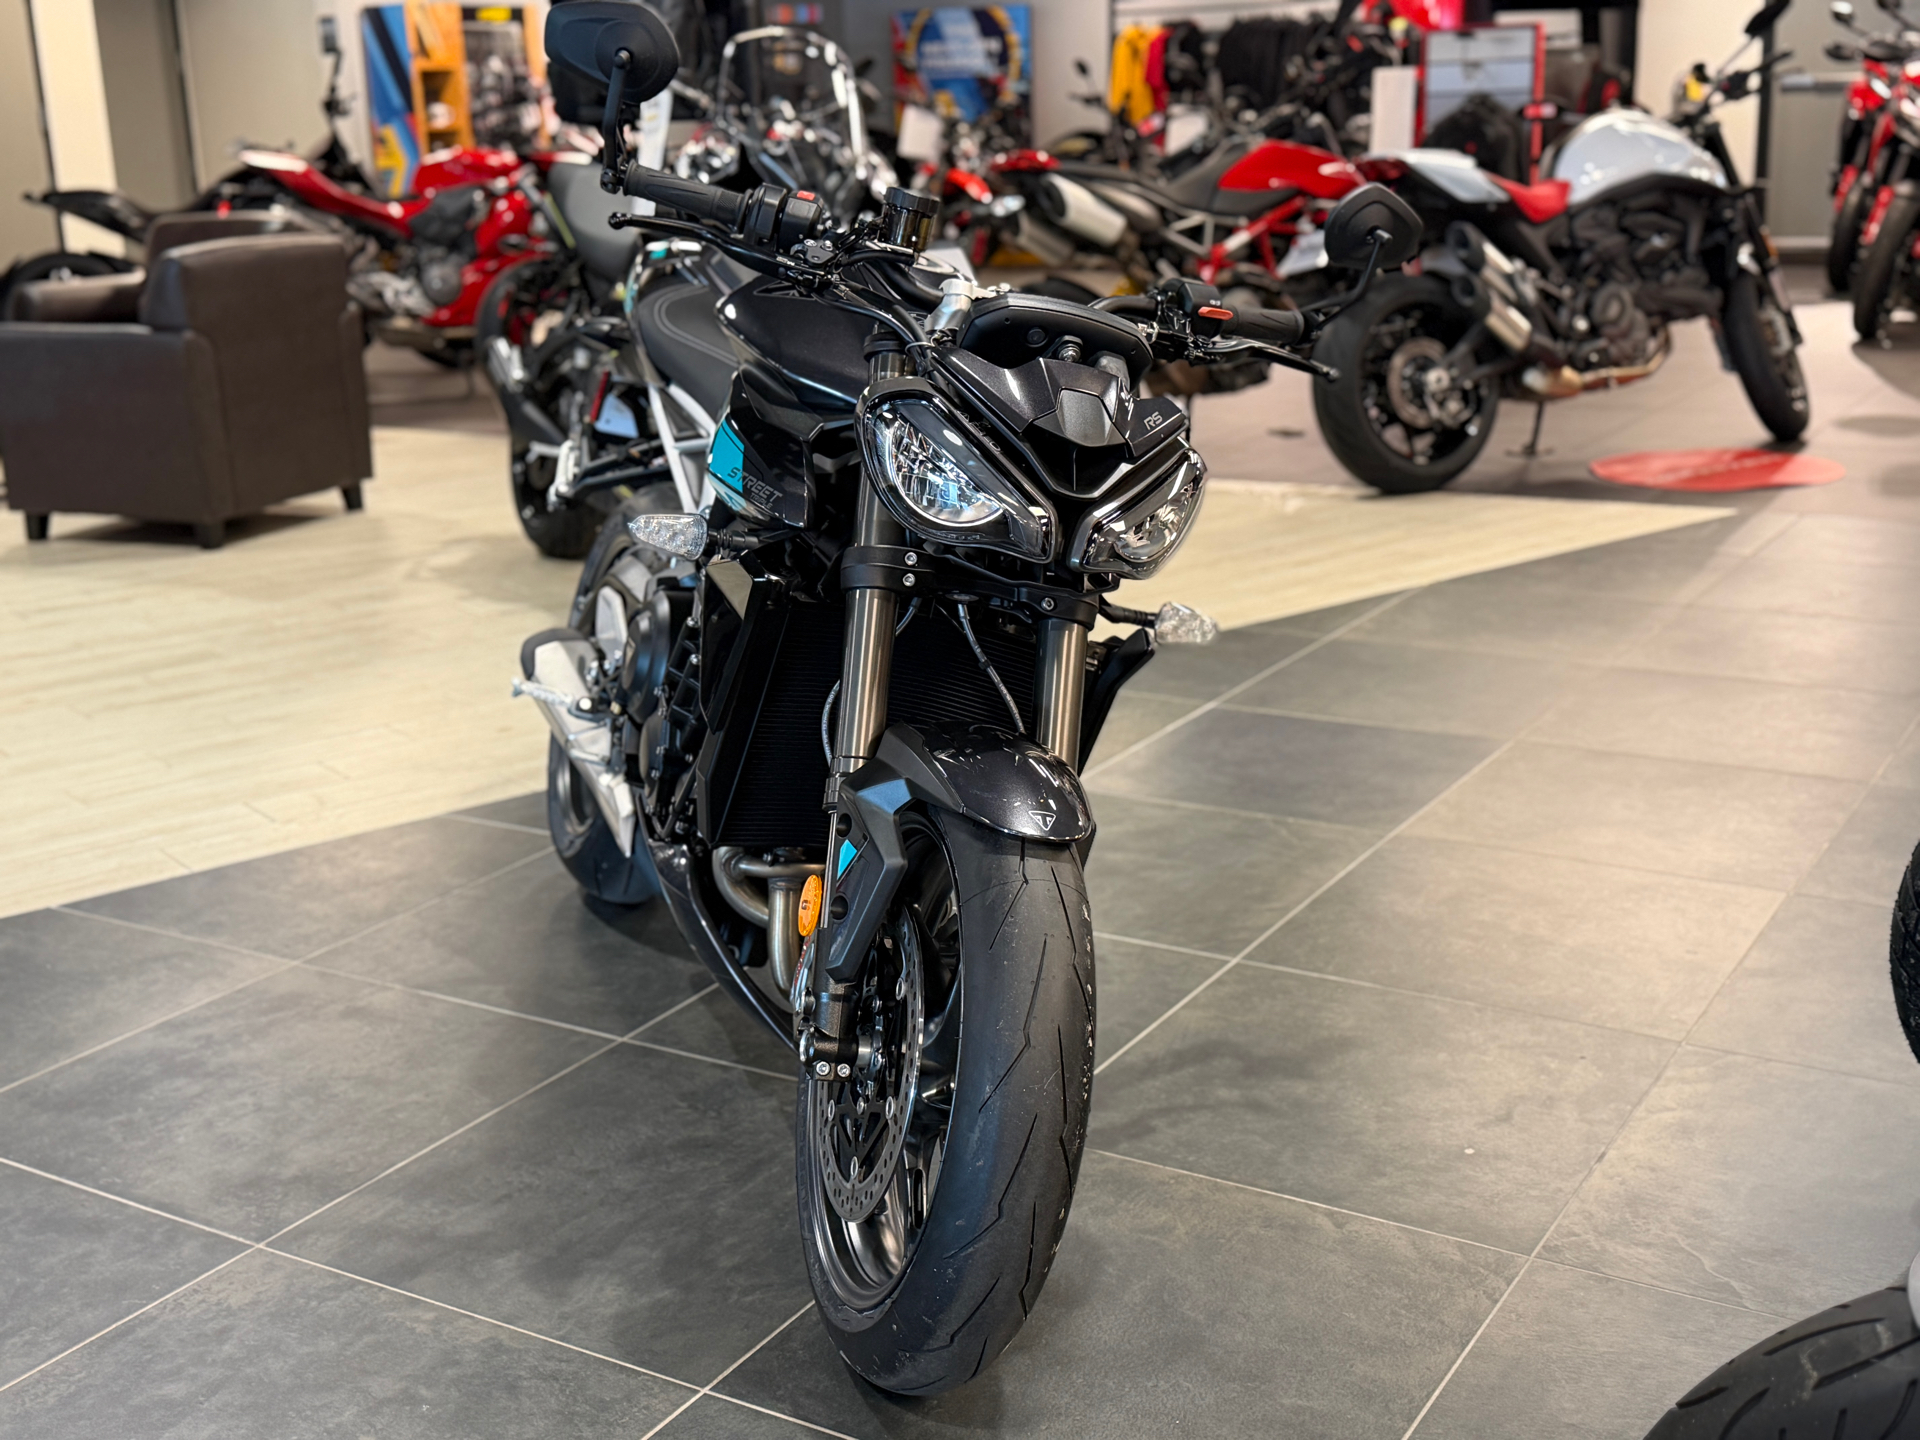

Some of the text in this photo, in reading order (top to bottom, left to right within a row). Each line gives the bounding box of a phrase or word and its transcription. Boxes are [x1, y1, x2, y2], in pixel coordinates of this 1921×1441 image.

[1143, 411, 1163, 430] RS
[727, 466, 784, 503] STREET
[750, 492, 774, 510] TRIPLE
